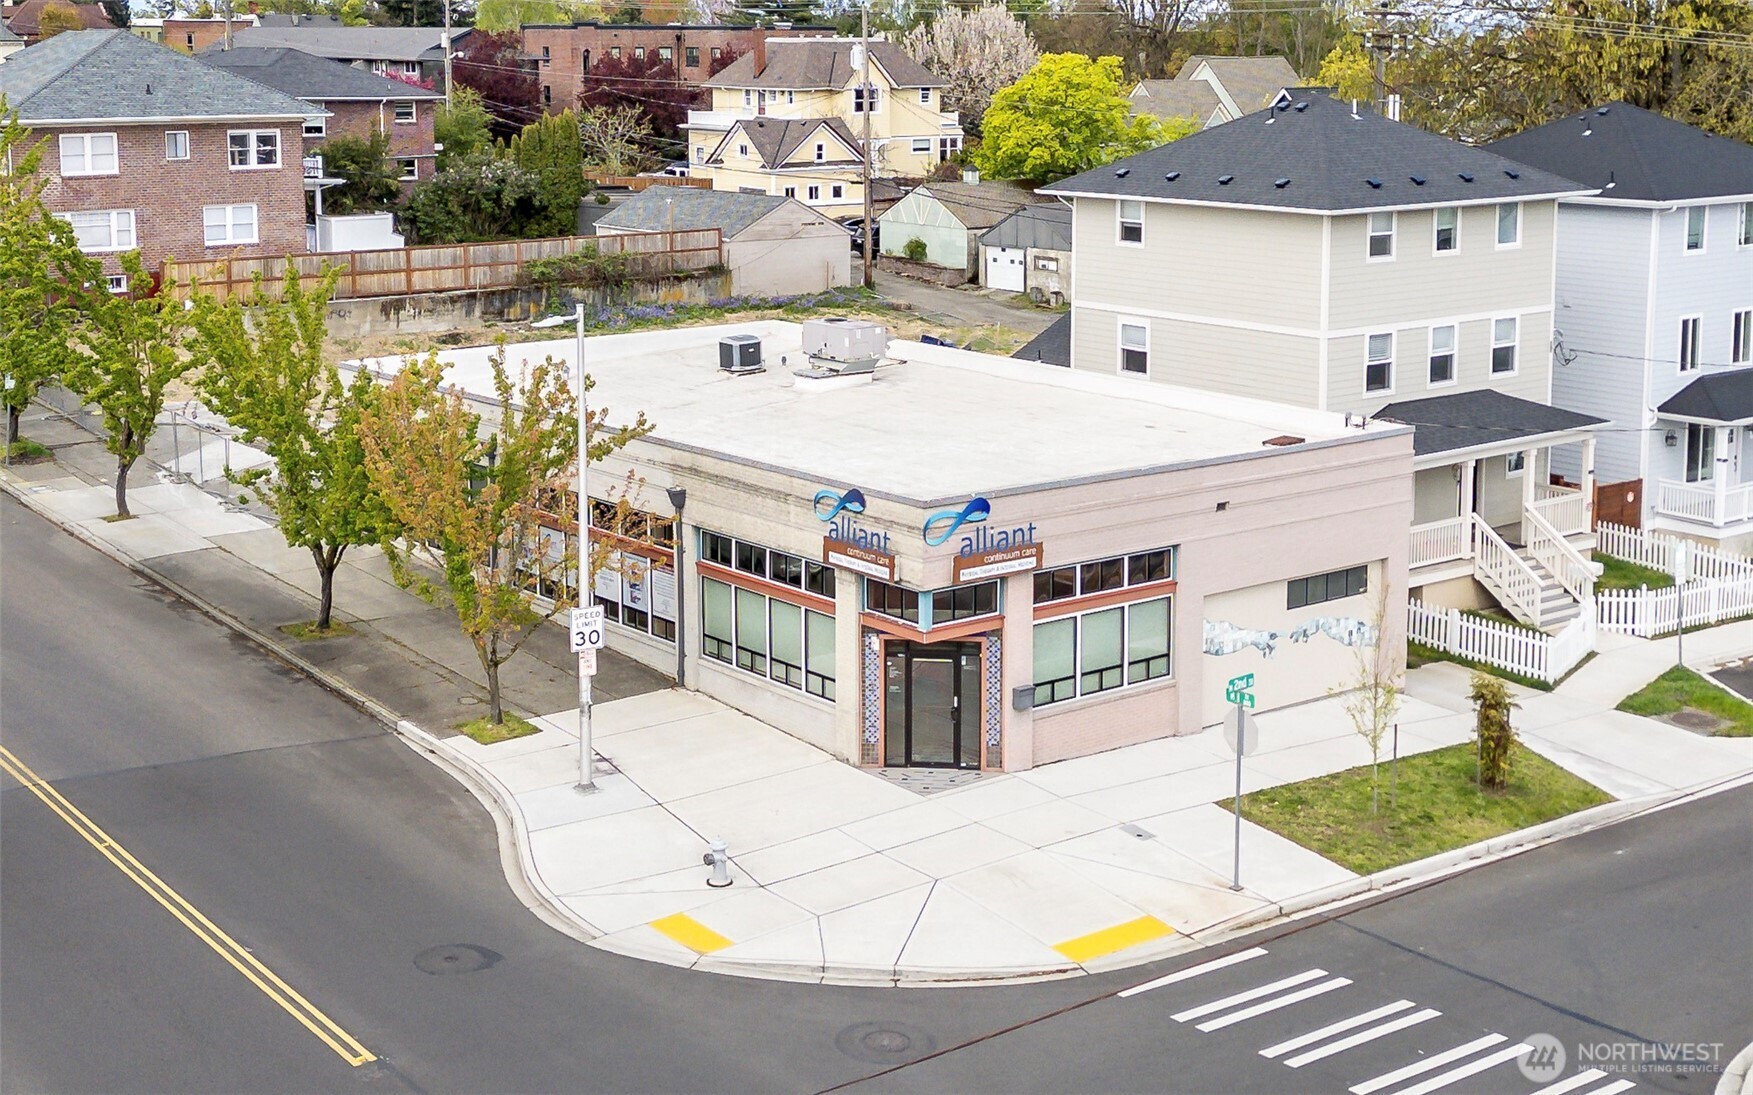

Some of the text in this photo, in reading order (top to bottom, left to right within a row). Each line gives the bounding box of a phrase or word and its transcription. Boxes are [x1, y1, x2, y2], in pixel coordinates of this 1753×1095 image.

[828, 515, 891, 556] alliant
[960, 522, 1037, 559] alliant
[984, 547, 1037, 563] continuum care
[573, 611, 601, 621] SPEED
[576, 620, 597, 629] LIMIT
[575, 629, 600, 647] 30
